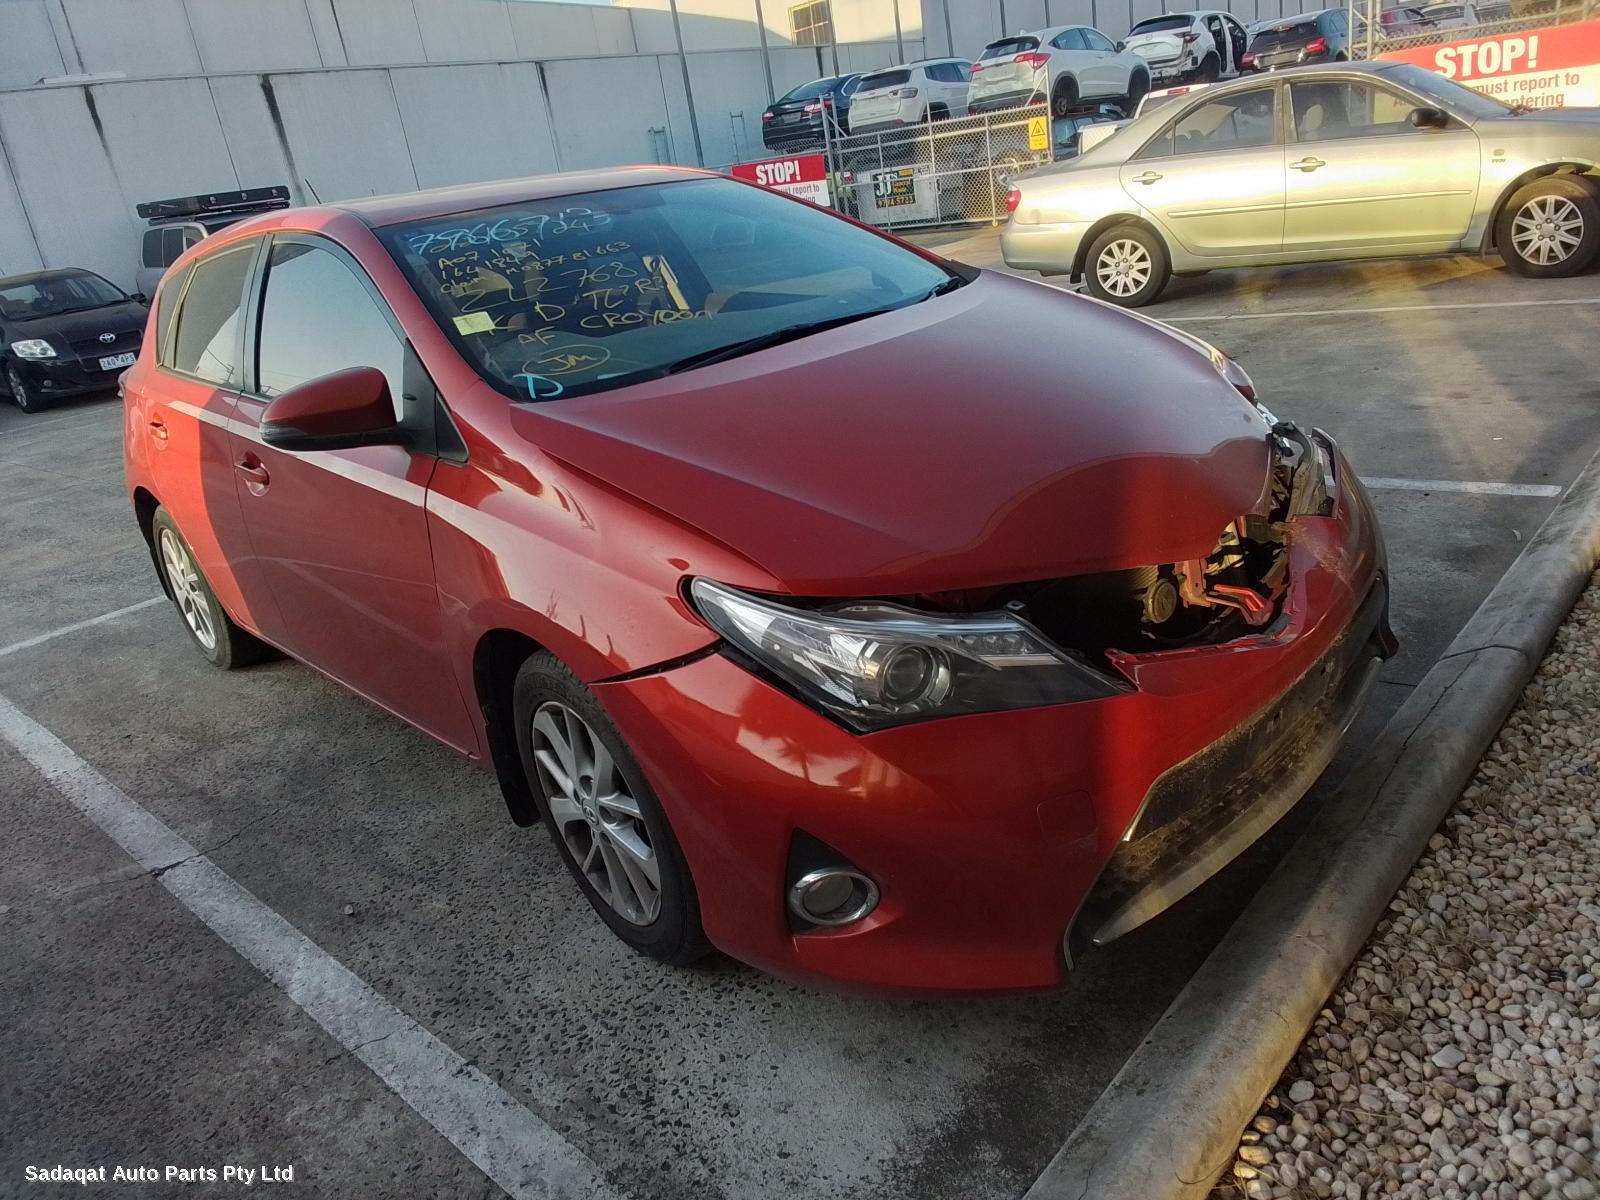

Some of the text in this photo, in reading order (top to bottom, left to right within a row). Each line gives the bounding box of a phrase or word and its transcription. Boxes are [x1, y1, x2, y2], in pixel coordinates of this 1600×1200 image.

[1433, 36, 1538, 79] STOP!
[1513, 73, 1561, 94] report
[1565, 72, 1580, 86] to
[756, 160, 801, 185] STOP!
[792, 183, 812, 195] report
[813, 183, 820, 192] to
